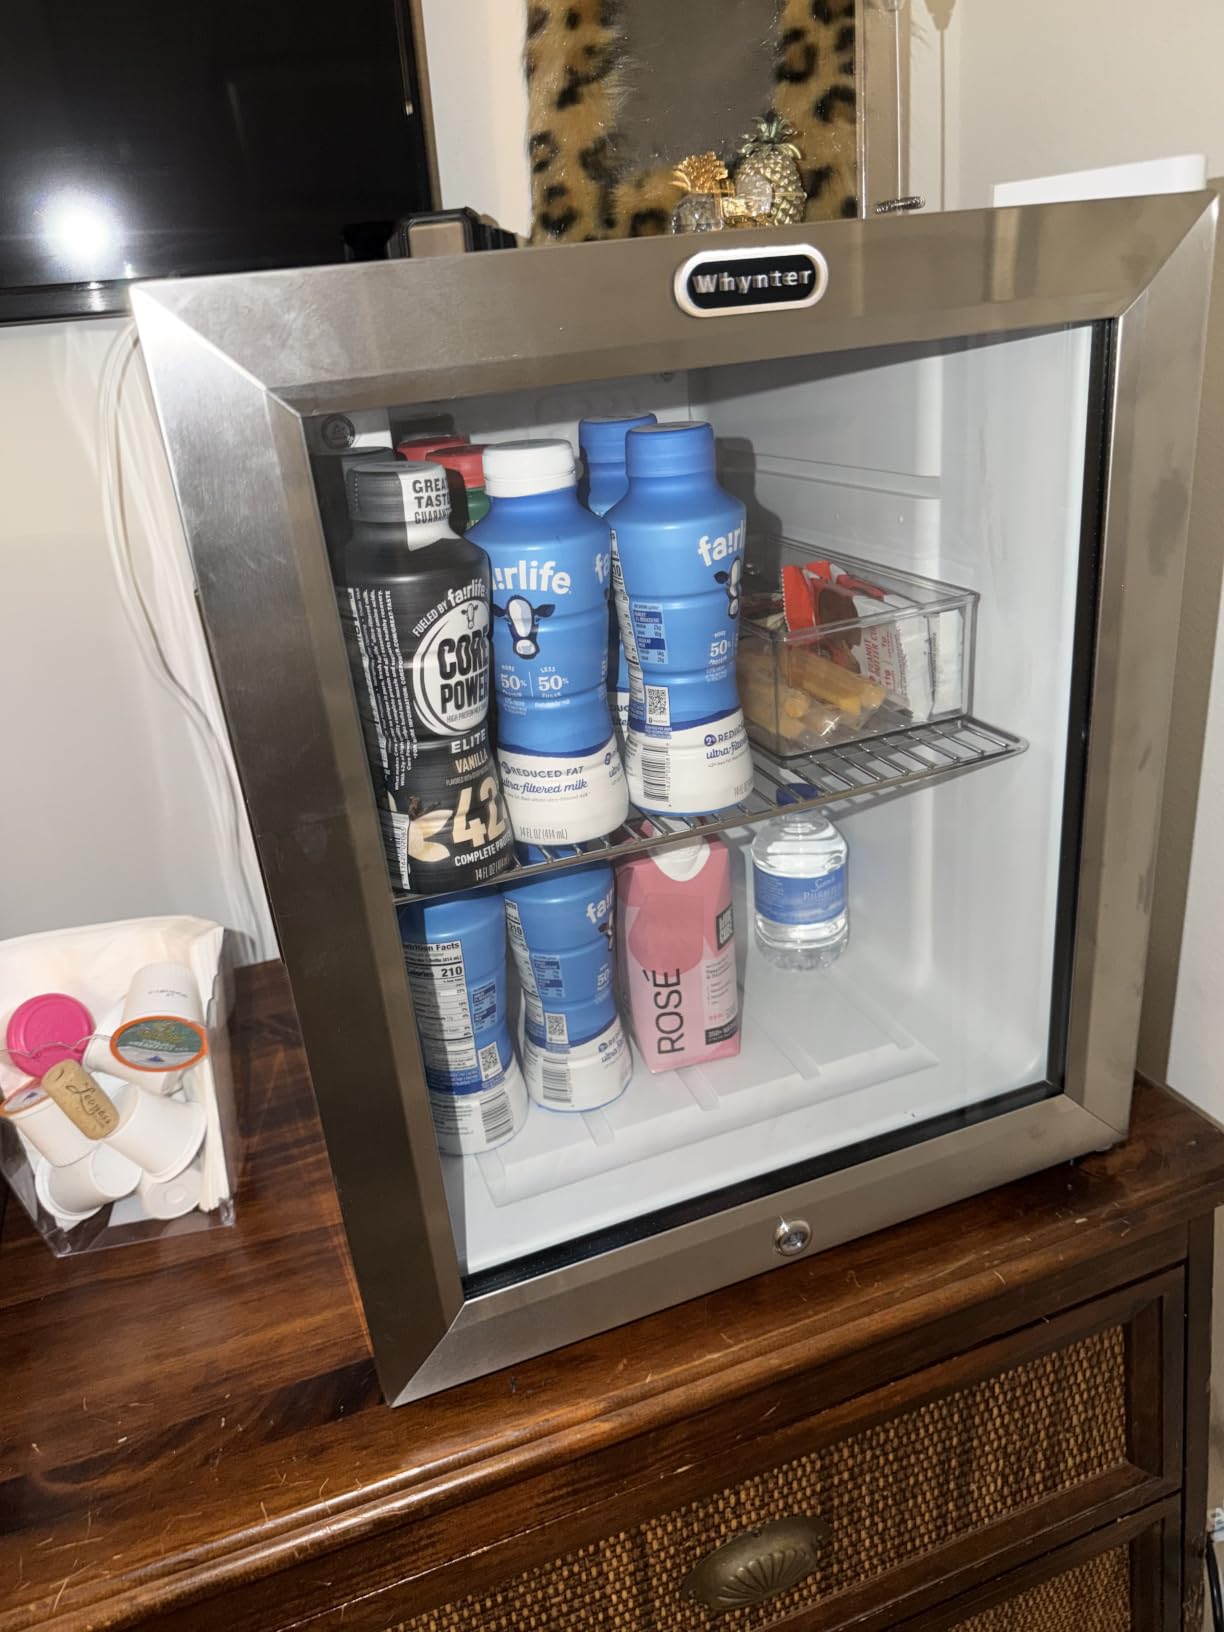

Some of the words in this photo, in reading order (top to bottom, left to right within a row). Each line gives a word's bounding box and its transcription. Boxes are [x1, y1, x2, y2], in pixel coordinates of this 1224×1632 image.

[692, 269, 813, 295] Whynter
[412, 477, 448, 494] GREA
[412, 609, 439, 637] FUELED
[436, 600, 448, 614] BY
[451, 728, 487, 754] ELITE
[455, 747, 489, 773] VANILLA
[510, 765, 562, 779] REDUCED
[566, 765, 585, 777] FAT
[564, 778, 589, 793] milk
[526, 826, 532, 839] FL
[455, 844, 496, 867] COMPLETE
[475, 867, 483, 881] 14
[436, 942, 460, 951] Facts
[441, 966, 463, 978] 210
[642, 968, 685, 1055] ROSÉ
